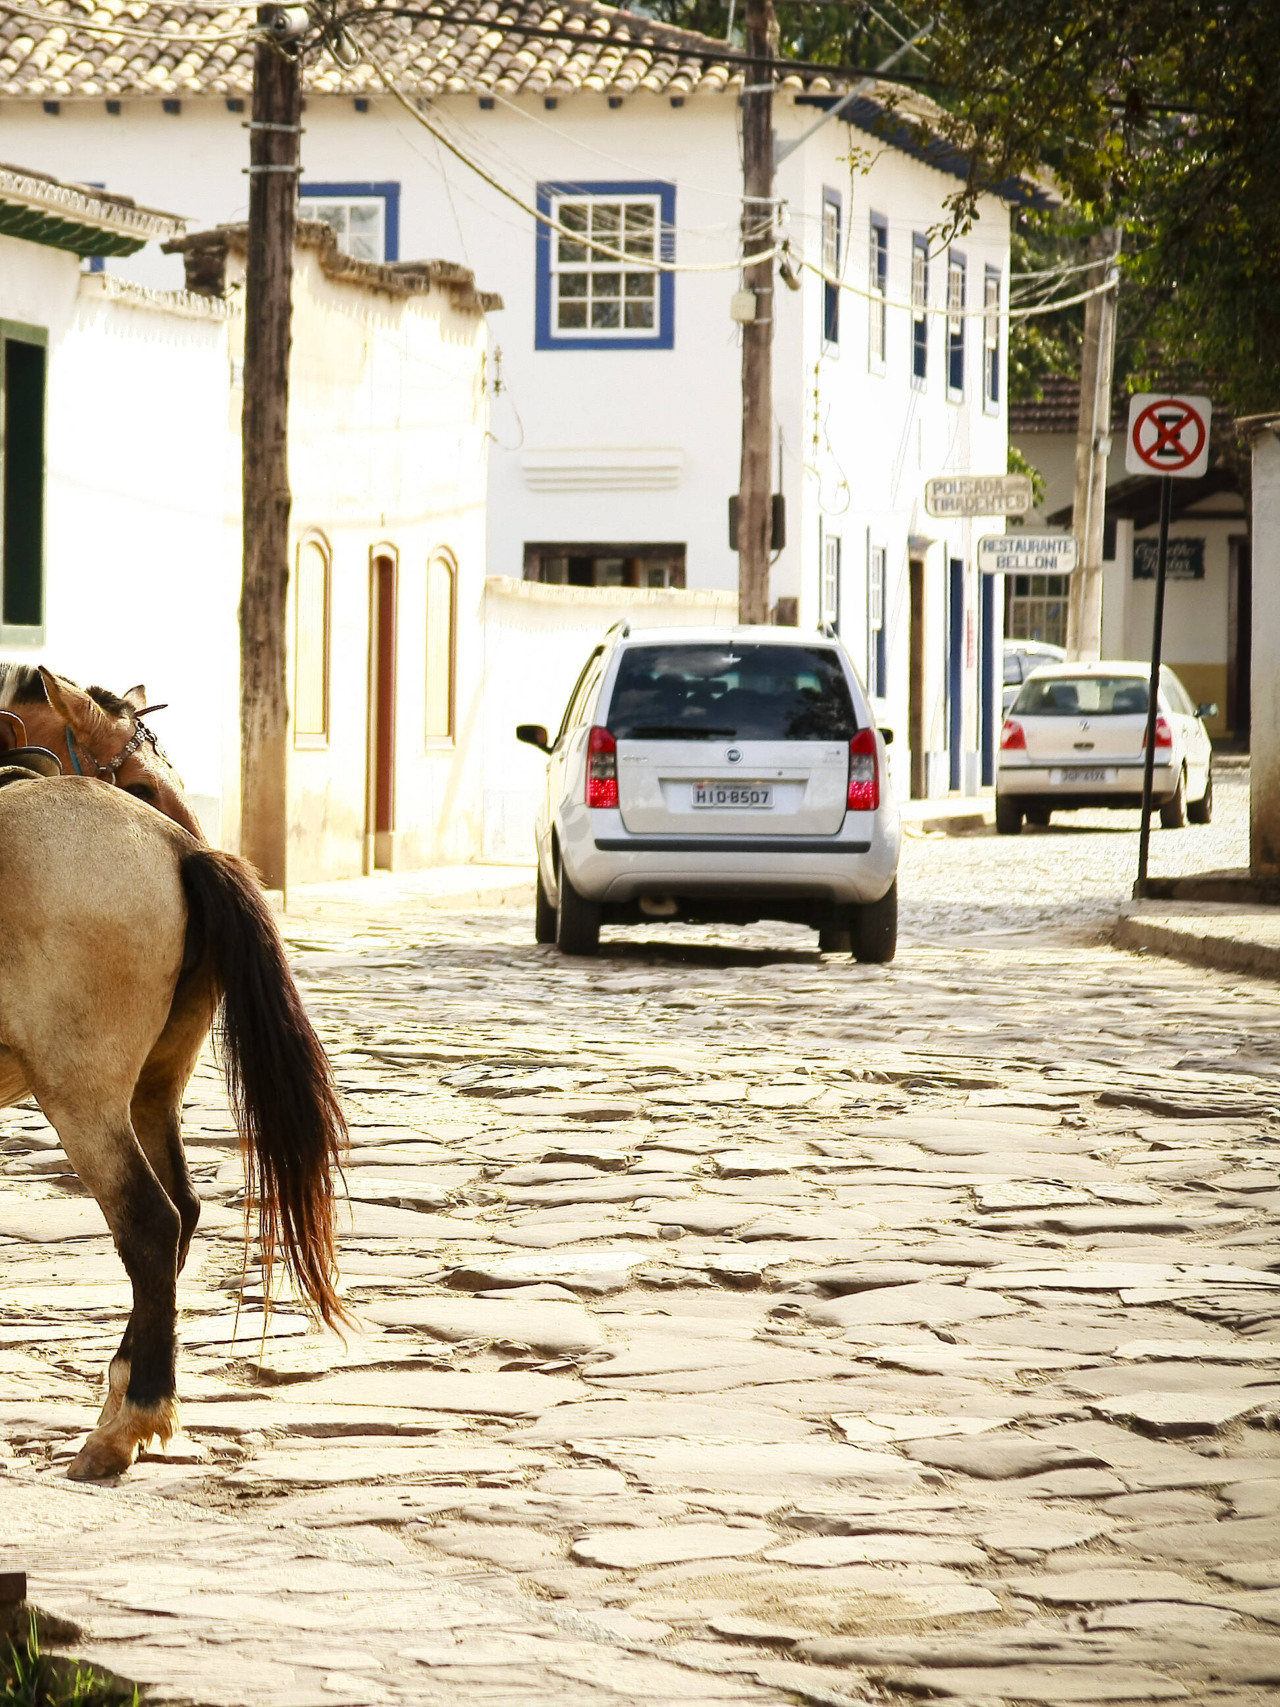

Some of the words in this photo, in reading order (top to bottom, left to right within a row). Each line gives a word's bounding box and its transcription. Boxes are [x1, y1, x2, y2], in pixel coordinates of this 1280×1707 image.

[932, 479, 1004, 496] POUSADA
[983, 539, 1072, 554] RESTAURANTE
[1135, 542, 1196, 558] Conelho
[996, 555, 1058, 569] BELLONI
